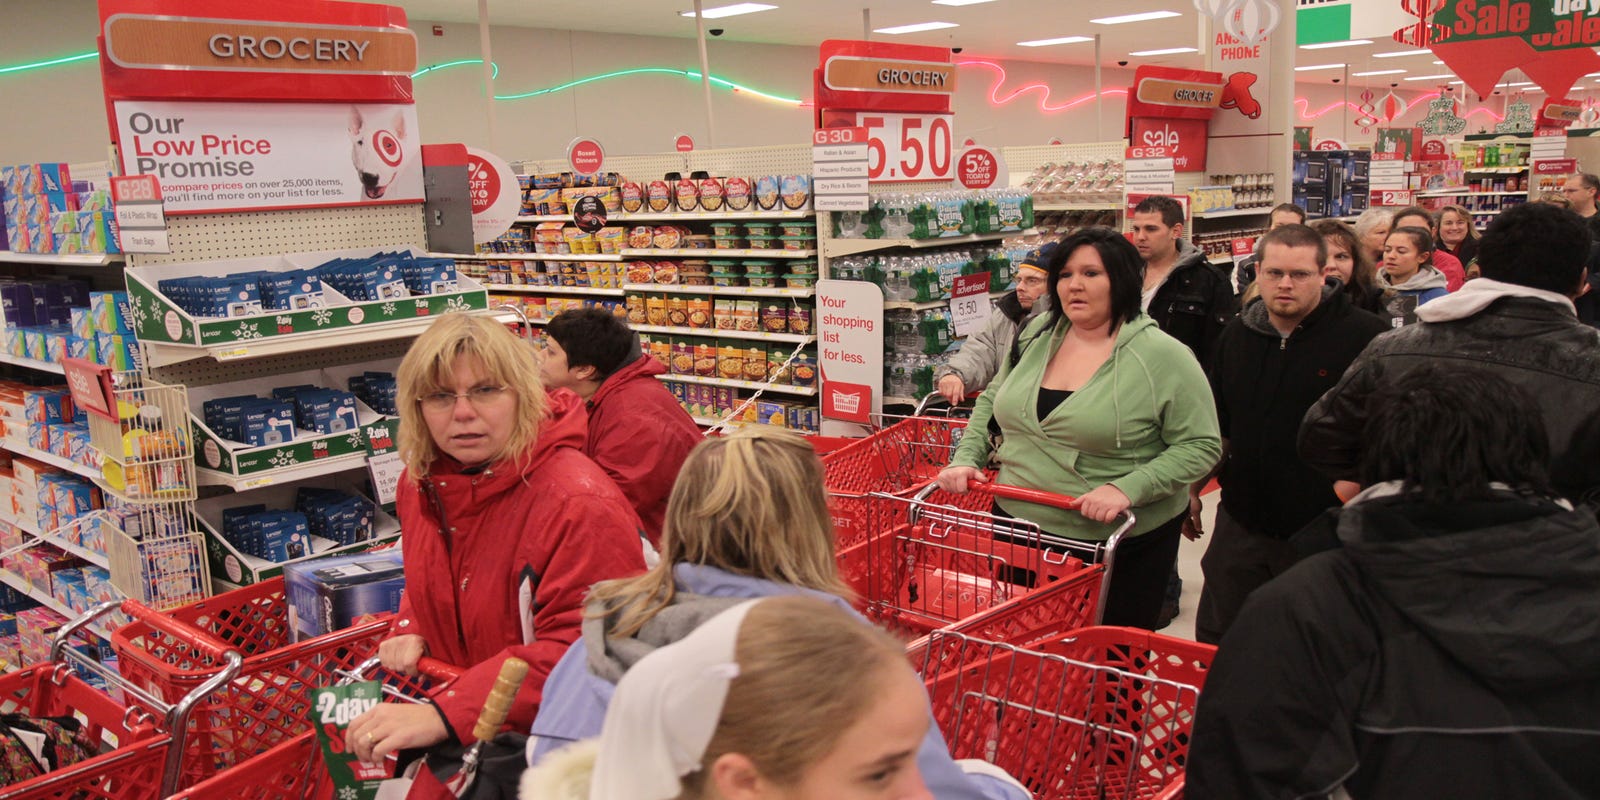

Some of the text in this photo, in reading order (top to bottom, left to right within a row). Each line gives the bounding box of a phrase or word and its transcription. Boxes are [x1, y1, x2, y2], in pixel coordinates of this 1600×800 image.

[1454, 0, 1530, 35] Sale
[209, 33, 370, 61] GROCERY
[1221, 45, 1260, 60] PHONE
[878, 68, 949, 86] GROCERY
[1175, 88, 1215, 102] GROCER
[129, 112, 184, 134] Our
[815, 129, 853, 143] G 30
[1143, 123, 1180, 153] sale
[133, 134, 271, 156] Low Price
[863, 117, 951, 178] 5.50
[1132, 147, 1166, 157] G 32
[137, 156, 254, 178] Promise
[966, 154, 990, 173] 5%
[162, 182, 208, 193] compare
[211, 181, 243, 192] prices
[282, 179, 313, 187] 25,000
[315, 178, 343, 186] items,
[162, 186, 344, 204] you'll find more on your list for less.
[956, 282, 986, 295] advertised
[957, 279, 965, 287] as
[820, 295, 846, 308] Your
[958, 300, 977, 316] 5.50
[823, 313, 874, 332] shopping
[823, 331, 840, 343] list
[823, 348, 866, 365] for less.
[314, 402, 330, 410] Lexar
[370, 437, 393, 449] Sale
[239, 459, 258, 468] Lexar
[831, 516, 851, 528] GET
[266, 530, 282, 538] Lexar
